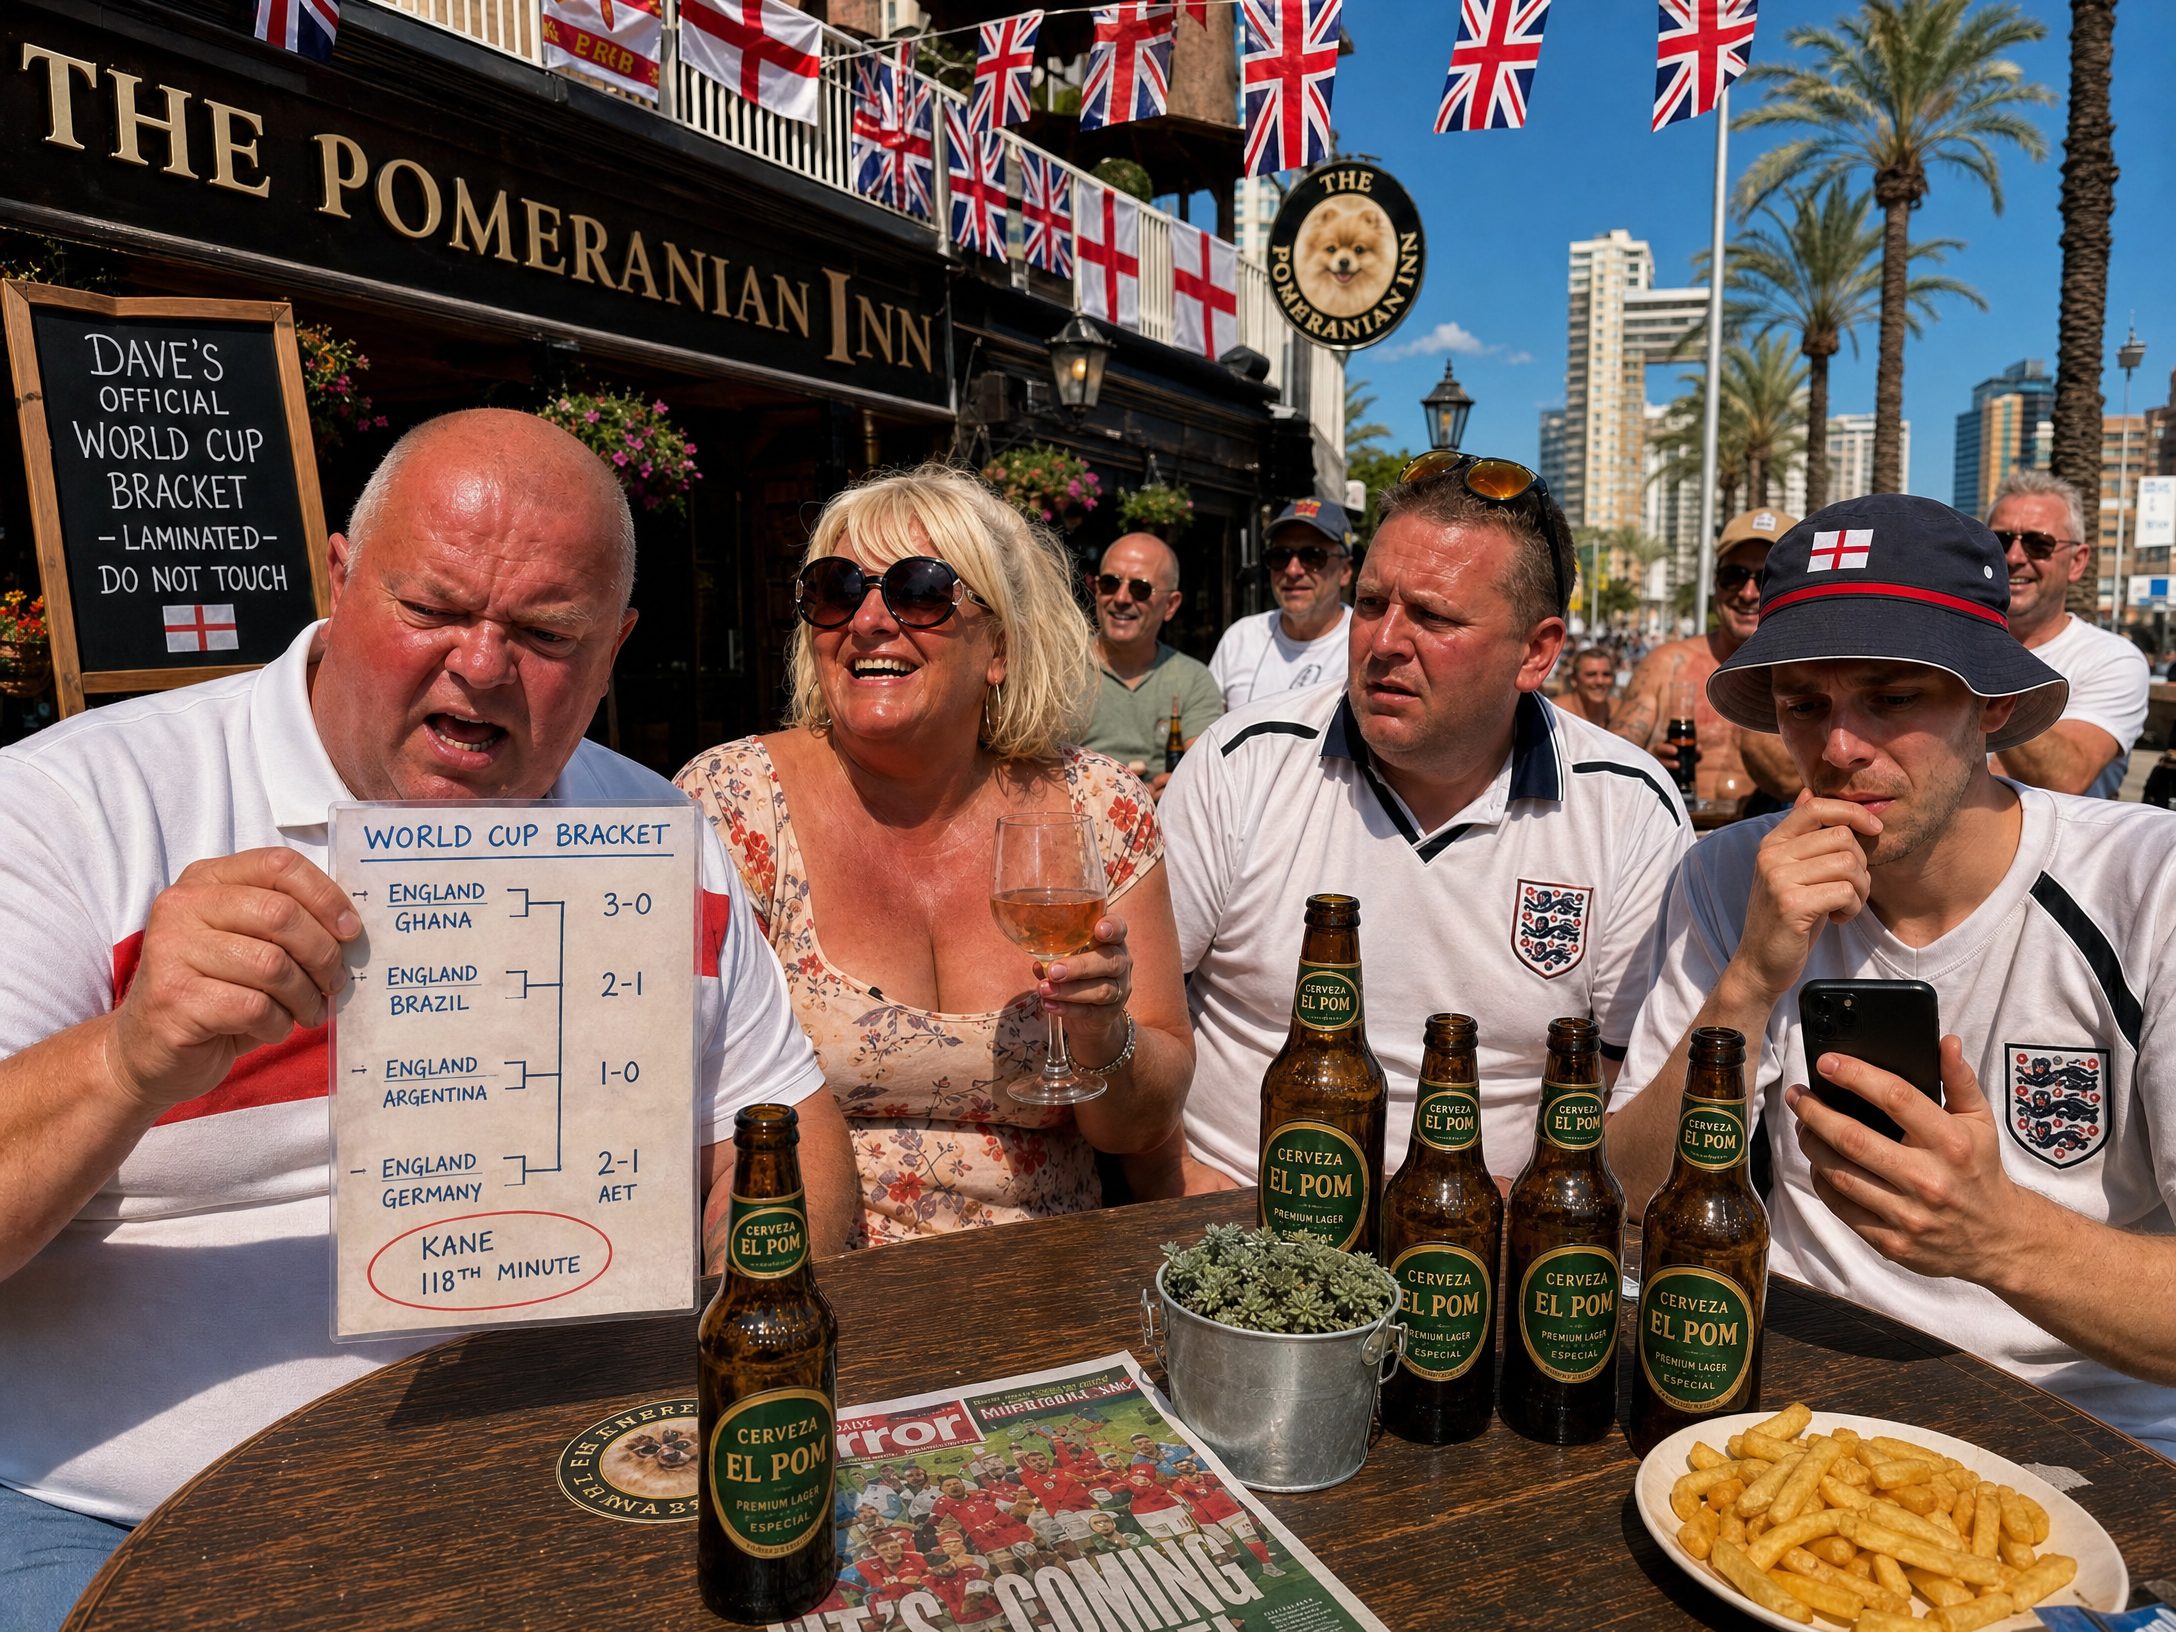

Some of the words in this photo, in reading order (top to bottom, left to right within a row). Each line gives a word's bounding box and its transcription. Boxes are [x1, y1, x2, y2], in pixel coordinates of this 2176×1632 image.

[1319, 170, 1374, 194] THE
[20, 42, 271, 199] THE
[311, 133, 810, 339] POMERANIAN
[821, 267, 933, 374] INN
[1272, 245, 1405, 340] POMERANIAN
[1397, 231, 1418, 288] INN
[84, 333, 223, 382] DAVE'S
[99, 386, 230, 416] OFFICIAL
[72, 420, 188, 461] WORLD
[206, 428, 264, 463] CUP
[107, 472, 247, 510] BRACKET
[98, 565, 139, 595] DO
[152, 565, 201, 593] NOT
[210, 564, 288, 592] TOUCH
[363, 824, 472, 849] WORLD
[488, 823, 539, 848] CUP
[556, 822, 671, 847] BRACKET
[388, 882, 485, 904] ENGLAND
[603, 892, 652, 918] 3-0
[395, 911, 472, 934] GHANA
[387, 965, 478, 987] ENGLAND
[601, 971, 642, 998] 2-1
[1305, 984, 1346, 995] CERVEZA
[390, 994, 470, 1016] BRAZIL
[1301, 994, 1316, 1010] EL
[1319, 996, 1350, 1011] POM
[385, 1056, 478, 1080] ENGLAND
[601, 1060, 640, 1086] 1-0
[382, 1084, 488, 1109] ARGENTINA
[1429, 1104, 1471, 1114] CERVEZA
[1559, 1105, 1598, 1114] CERVEZA
[1425, 1114, 1441, 1130] EL
[1446, 1115, 1474, 1131] POM
[1555, 1115, 1571, 1130] EL
[1576, 1115, 1601, 1131] POM
[1689, 1119, 1732, 1132] CERVEZA
[1684, 1129, 1699, 1147] EL
[1704, 1133, 1736, 1149] POM
[382, 1153, 477, 1179] ENGLAND
[598, 1148, 639, 1176] 2-1
[1277, 1147, 1343, 1166] CERVEZA
[1269, 1166, 1293, 1195] EL
[1299, 1173, 1353, 1198] POM
[382, 1182, 483, 1210] GERMANY
[598, 1183, 638, 1204] AET
[1273, 1207, 1313, 1223] PREMIUM
[1315, 1214, 1344, 1224] LAGER
[746, 1221, 796, 1236] CERVEZA
[422, 1230, 494, 1261] KANE
[741, 1238, 762, 1256] EL
[767, 1232, 801, 1256] POM
[497, 1255, 580, 1281] MINUTE
[1407, 1269, 1472, 1287] CERVEZA
[1546, 1272, 1608, 1287] CERVEZA
[1400, 1287, 1425, 1316] EL
[1430, 1291, 1480, 1318] POM
[1534, 1290, 1563, 1318] EL
[1569, 1289, 1614, 1318] POM
[1660, 1291, 1728, 1314] CERVEZA
[1408, 1328, 1444, 1341] REMIUM
[1445, 1331, 1471, 1342] LAGER
[1541, 1330, 1582, 1342] PREMIUM
[1584, 1329, 1607, 1342] LAGER
[1650, 1309, 1675, 1340] EL
[1682, 1320, 1738, 1347] POM
[1414, 1347, 1462, 1359] ESPECIAL
[1551, 1349, 1598, 1360] ESPECIAL
[1698, 1362, 1728, 1372] LAGER
[1663, 1373, 1716, 1390] ESPECIAL
[737, 1416, 818, 1445] CERVEZA
[836, 1413, 962, 1458] rror
[726, 1452, 762, 1483] EL
[771, 1434, 828, 1482] POM
[736, 1498, 789, 1512] PREMIUM
[791, 1484, 819, 1505] LAGER
[750, 1511, 811, 1533] ESPECIAL
[993, 1533, 1265, 1632] COMING
